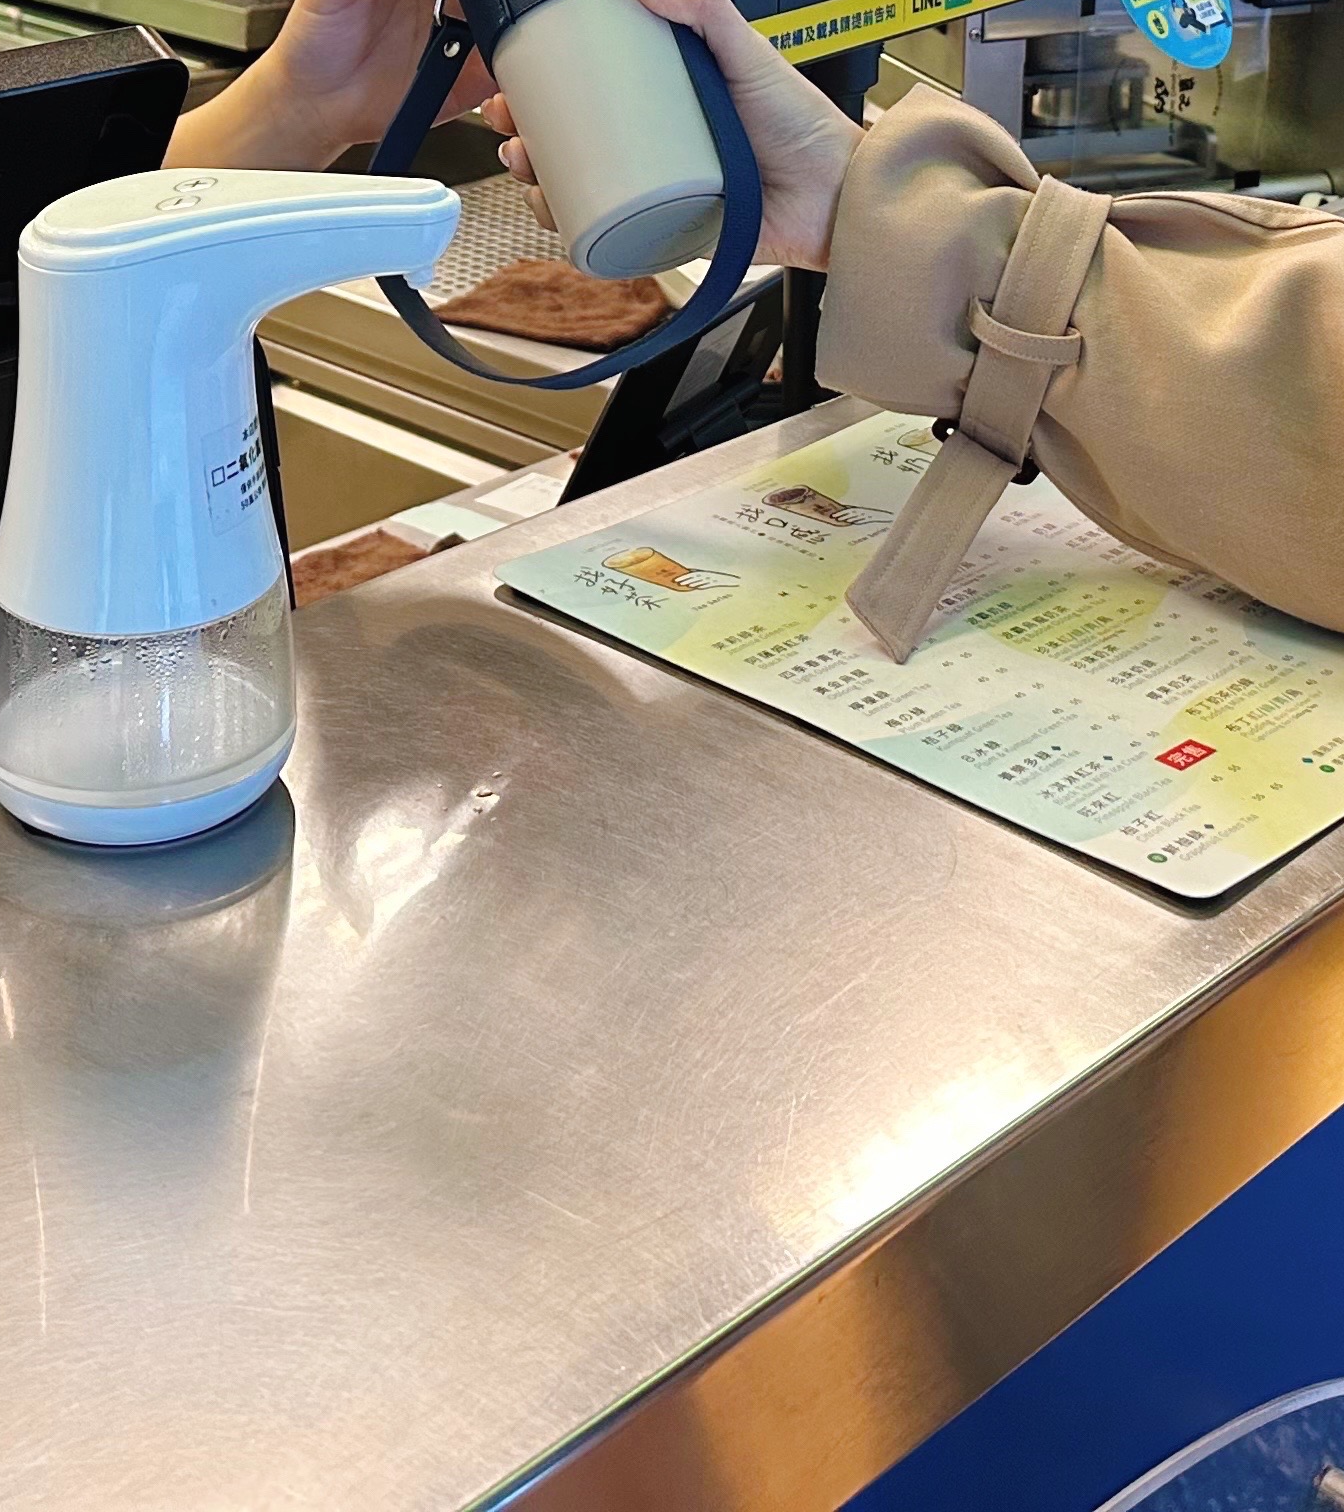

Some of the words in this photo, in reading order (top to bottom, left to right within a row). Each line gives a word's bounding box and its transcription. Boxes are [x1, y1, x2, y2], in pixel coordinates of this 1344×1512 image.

[573, 566, 671, 611] 找好茶
[1164, 742, 1209, 767] 完售
